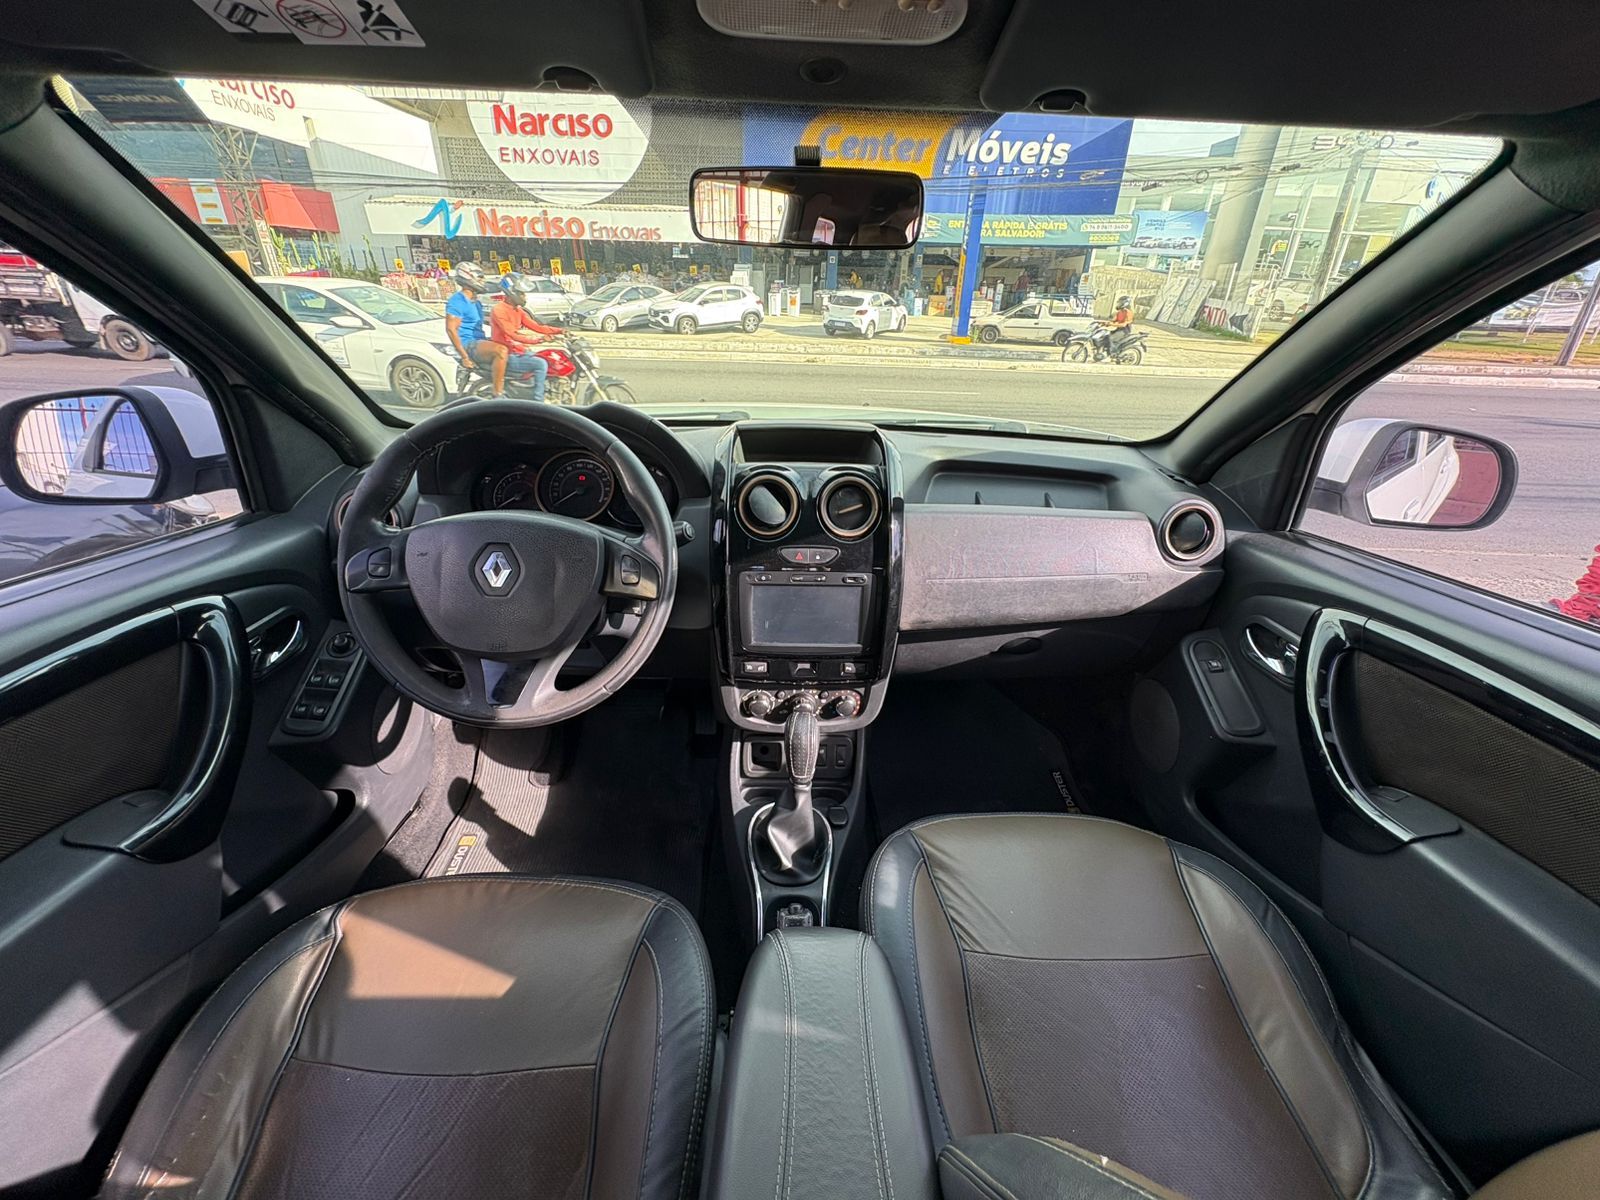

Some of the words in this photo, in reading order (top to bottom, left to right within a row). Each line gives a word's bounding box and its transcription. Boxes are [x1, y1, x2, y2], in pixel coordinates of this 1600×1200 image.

[208, 79, 296, 110] arciso
[210, 89, 276, 122] ENXOVAIS
[491, 103, 613, 139] Narciso
[499, 146, 600, 166] ENXOVAIS
[819, 123, 933, 163] Center
[946, 127, 1072, 166] Móveis
[475, 207, 586, 239] Narciso
[589, 220, 662, 241] Enxovais
[991, 219, 1025, 230] RÁPIDA
[1035, 220, 1068, 231] GRÁTIS
[1053, 771, 1075, 807] DUSTER
